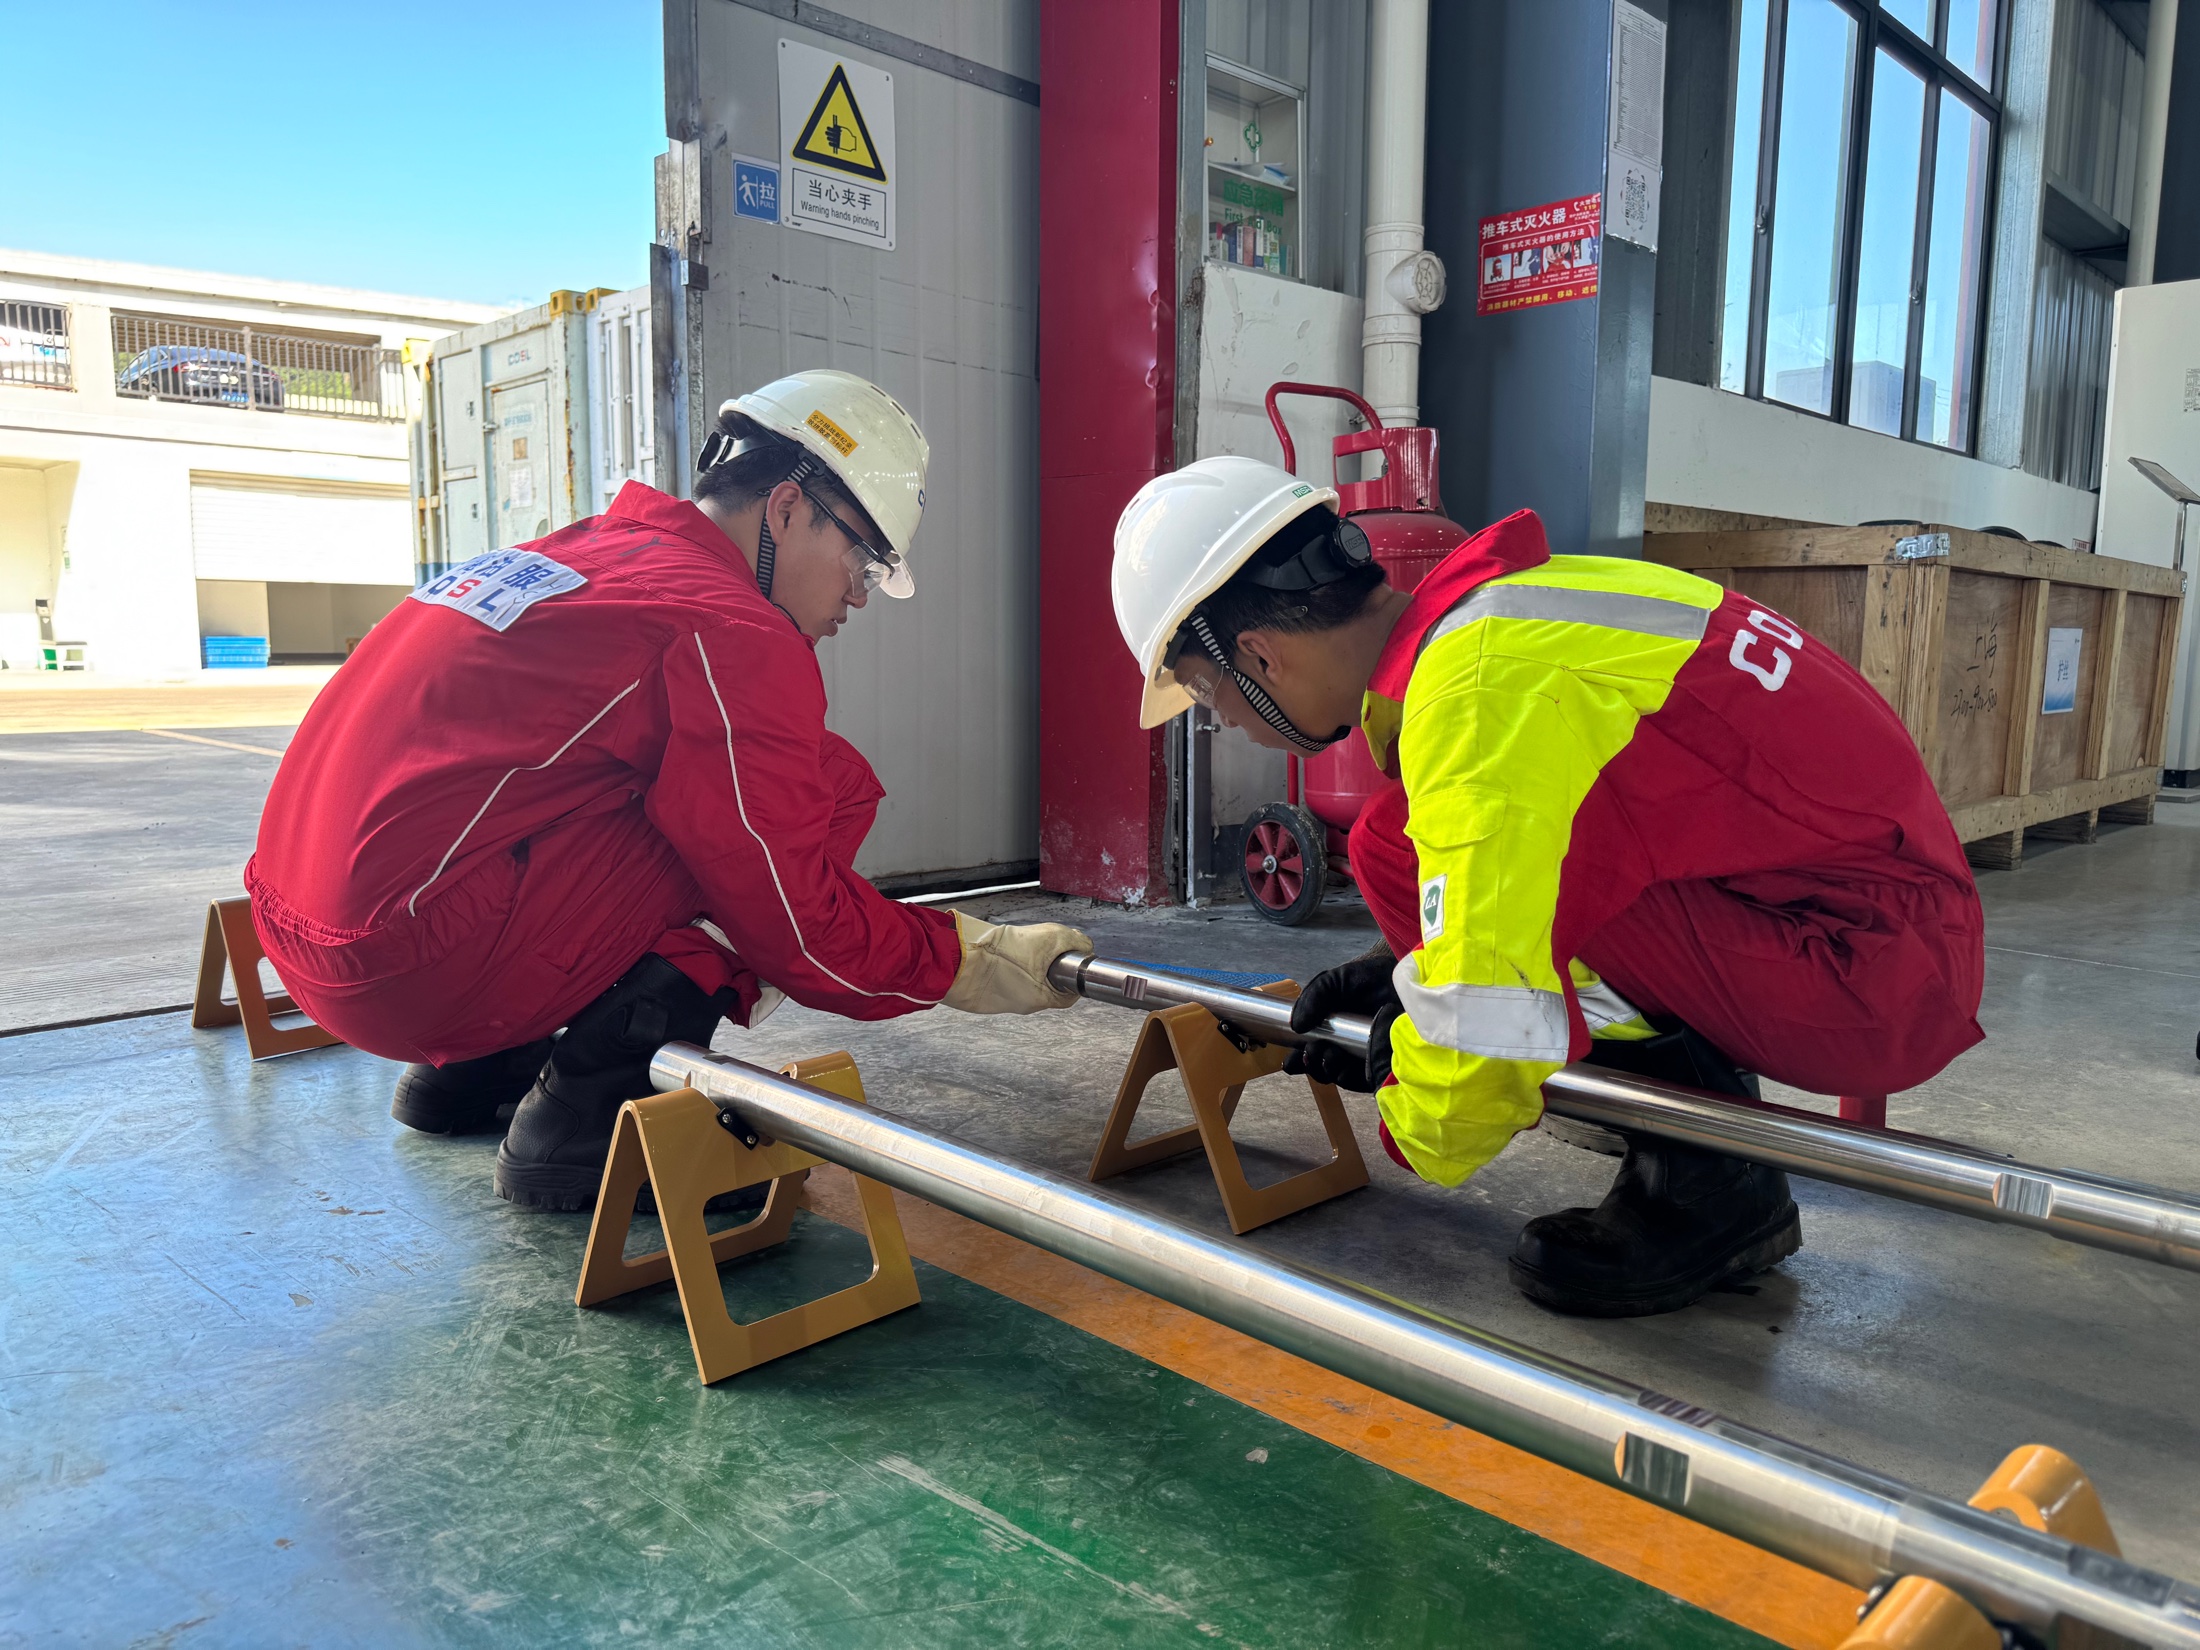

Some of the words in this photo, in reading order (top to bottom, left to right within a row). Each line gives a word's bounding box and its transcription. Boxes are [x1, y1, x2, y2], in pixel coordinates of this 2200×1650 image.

[759, 181, 775, 201] 拉
[760, 200, 775, 209] PULL
[809, 179, 872, 210] 当心夹手
[801, 200, 830, 218] Warning
[831, 208, 851, 221] hands
[853, 214, 879, 231] pinching
[1225, 208, 1243, 224] First
[1266, 220, 1282, 235] Box
[1482, 207, 1566, 240] 推车式灭火器
[1502, 228, 1585, 251] 推车式灭火器的使用方法
